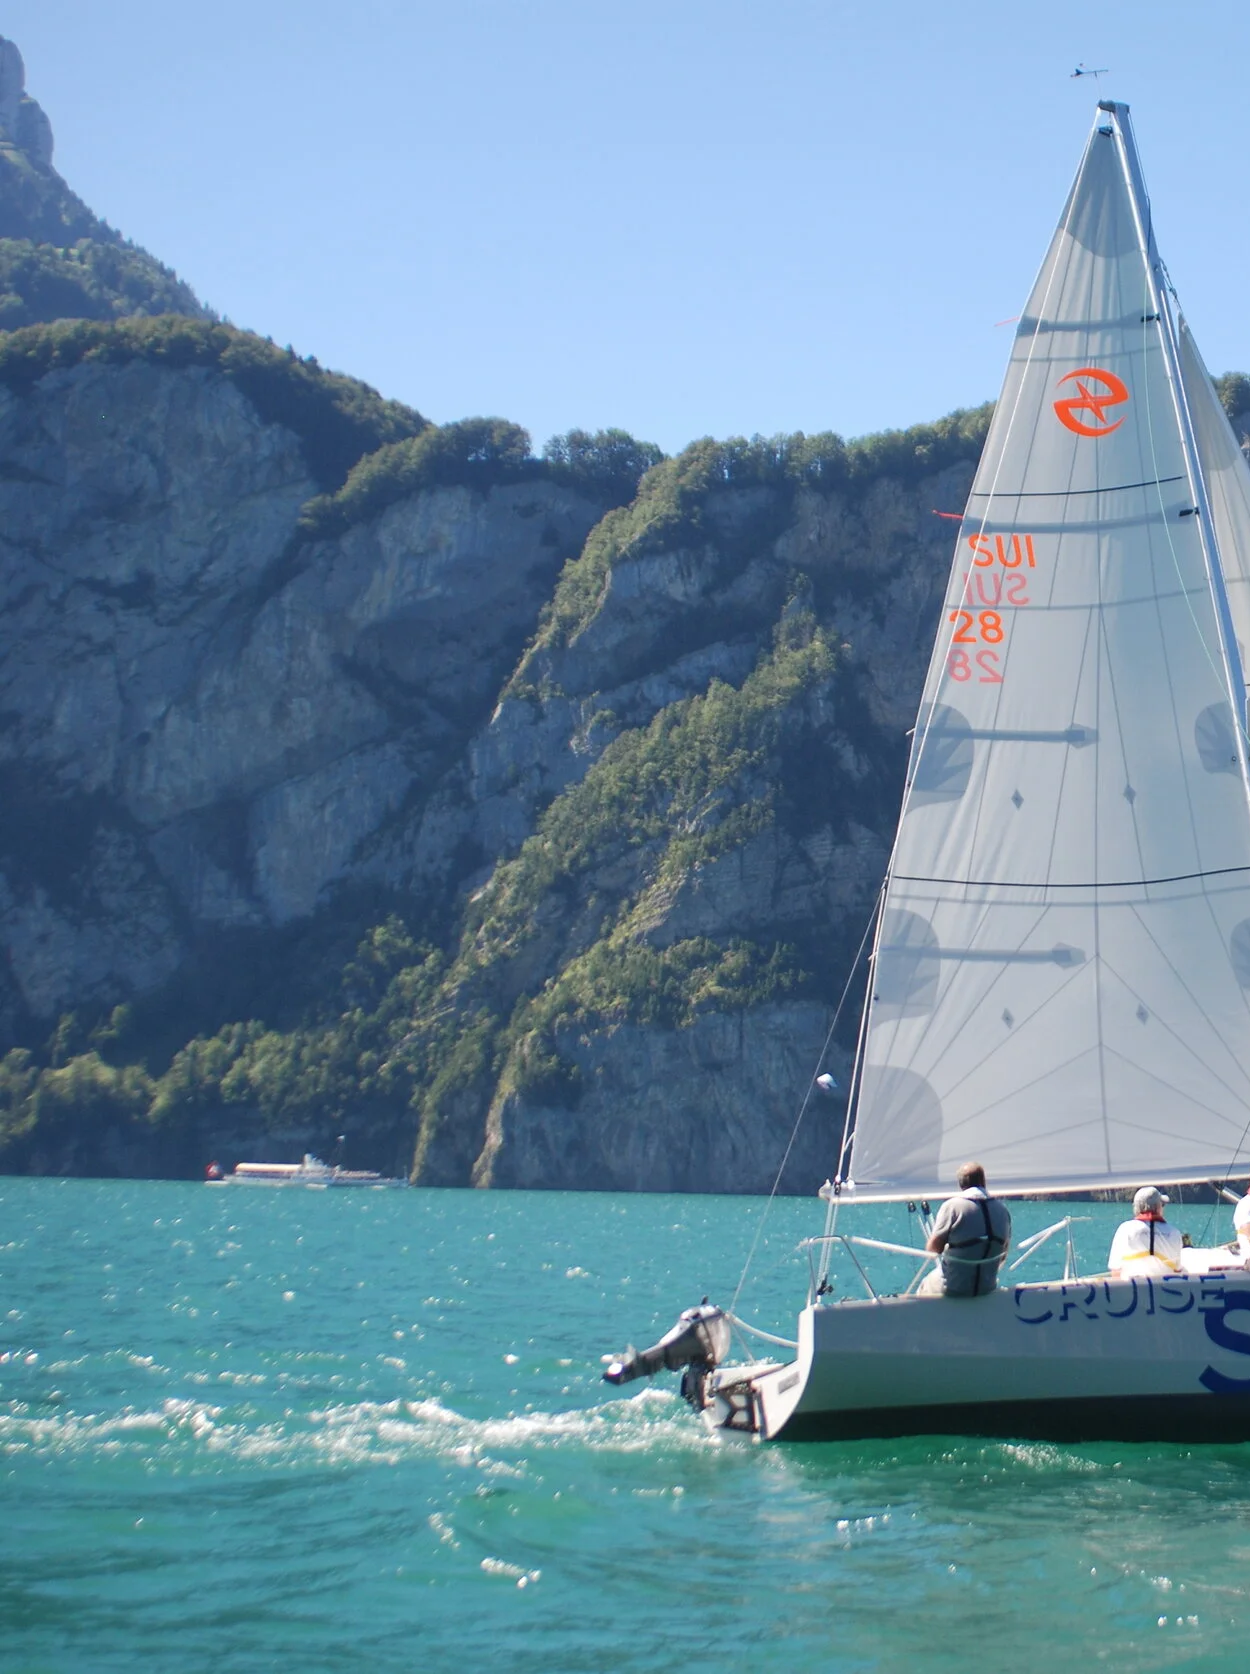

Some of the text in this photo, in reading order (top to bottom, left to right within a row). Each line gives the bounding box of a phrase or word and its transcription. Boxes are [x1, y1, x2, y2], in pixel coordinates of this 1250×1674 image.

[968, 533, 1036, 568] SUI
[949, 610, 1004, 643] 28
[1014, 1273, 1226, 1325] CRUISE
